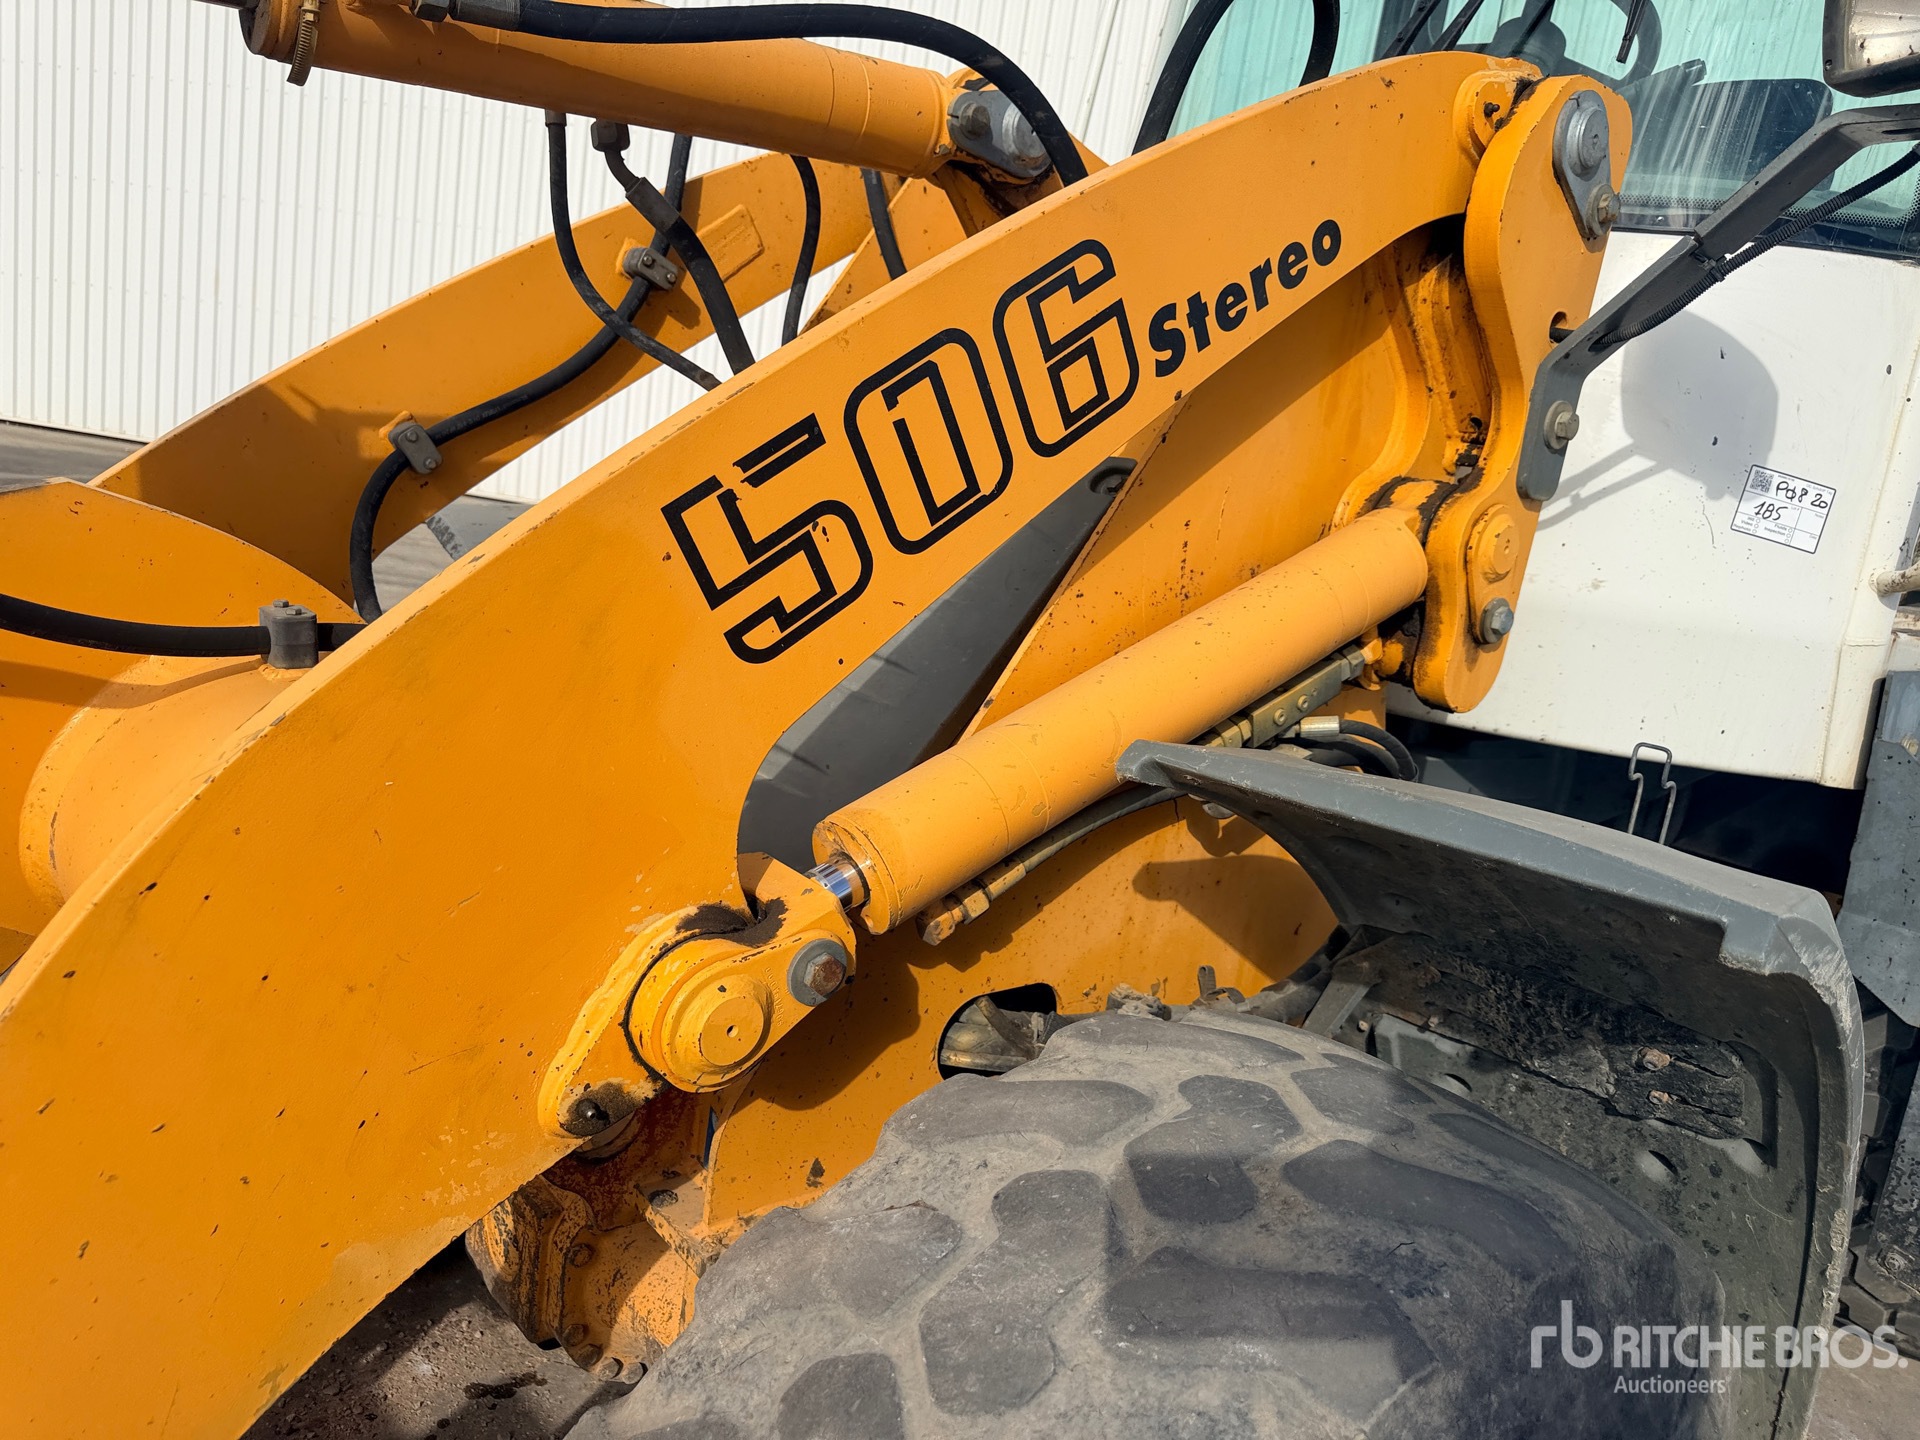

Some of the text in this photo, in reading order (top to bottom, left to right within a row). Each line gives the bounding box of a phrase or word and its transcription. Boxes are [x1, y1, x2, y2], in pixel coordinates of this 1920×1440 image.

[660, 219, 1342, 664] 506 Stereo
[1753, 501, 1789, 521] 185
